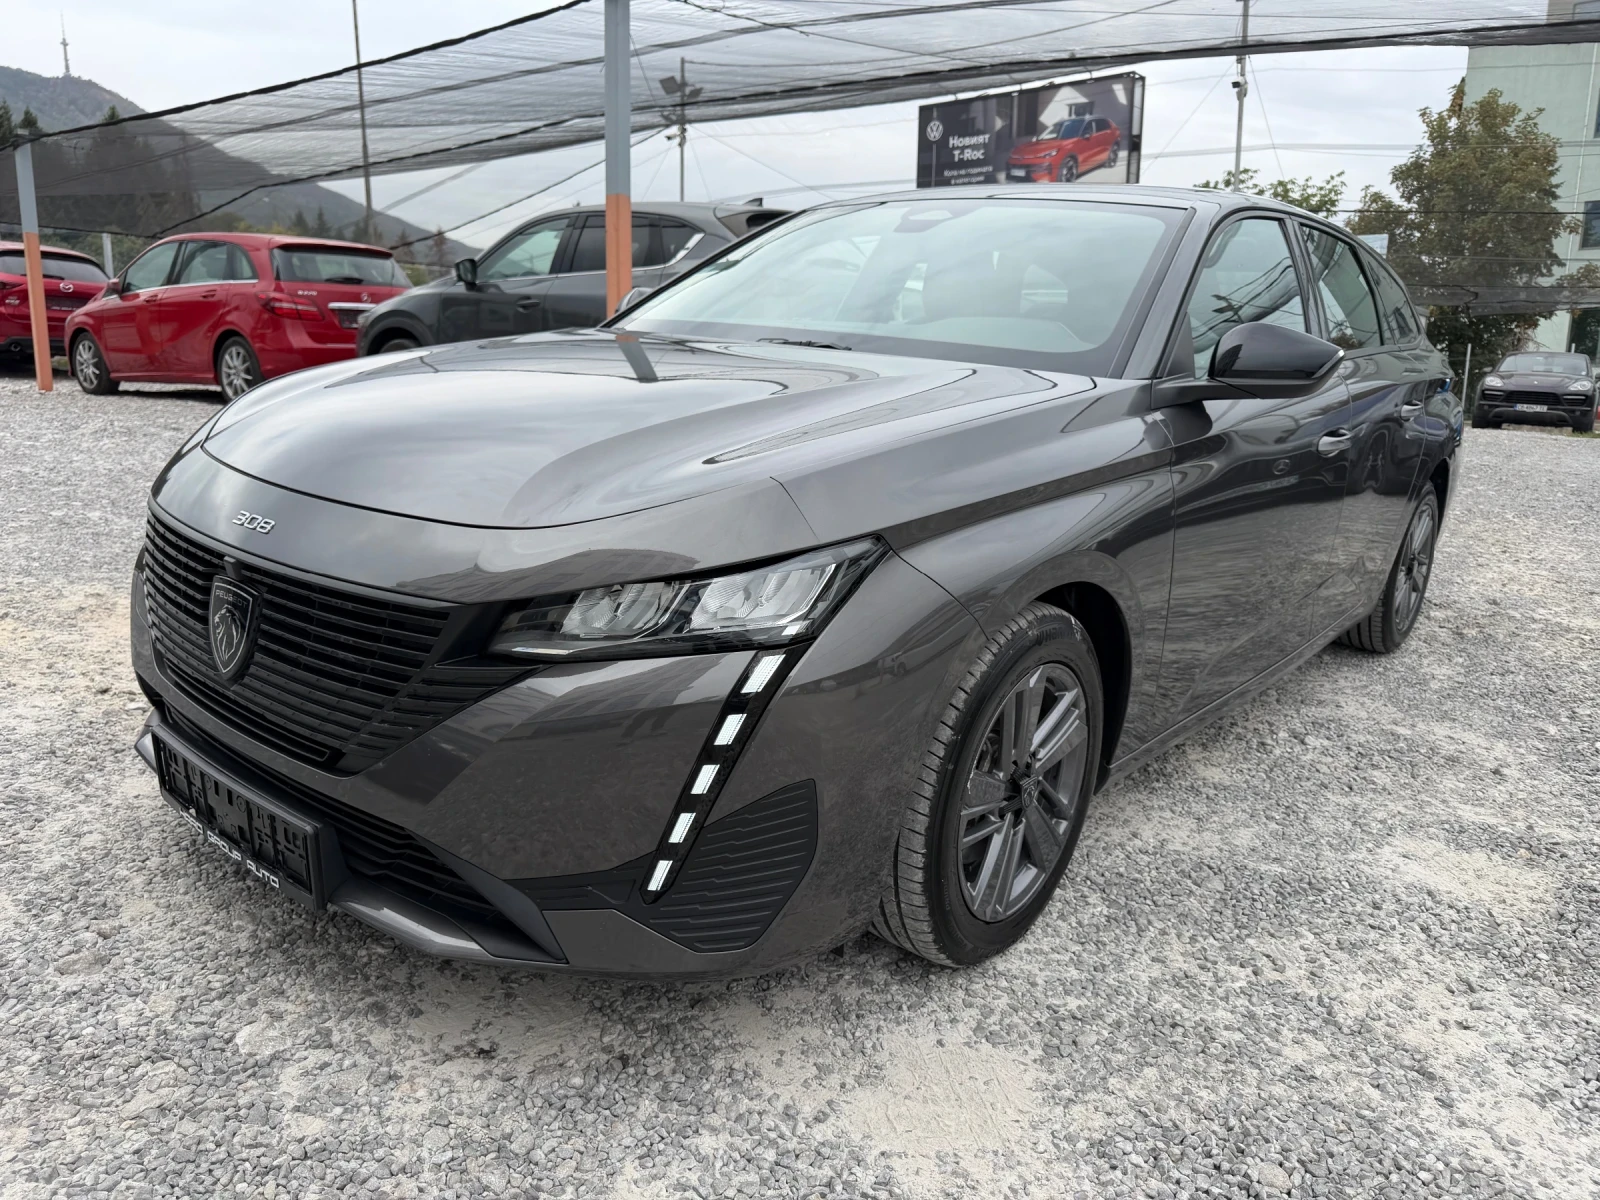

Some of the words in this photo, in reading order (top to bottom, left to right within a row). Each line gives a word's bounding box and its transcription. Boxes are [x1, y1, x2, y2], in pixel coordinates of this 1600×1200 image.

[948, 133, 990, 149] Новият
[952, 148, 985, 162] T-Roc
[232, 510, 276, 534] 308
[215, 589, 248, 609] PEUGEOT
[206, 830, 242, 861] GROUP
[246, 860, 279, 889] AUTO
